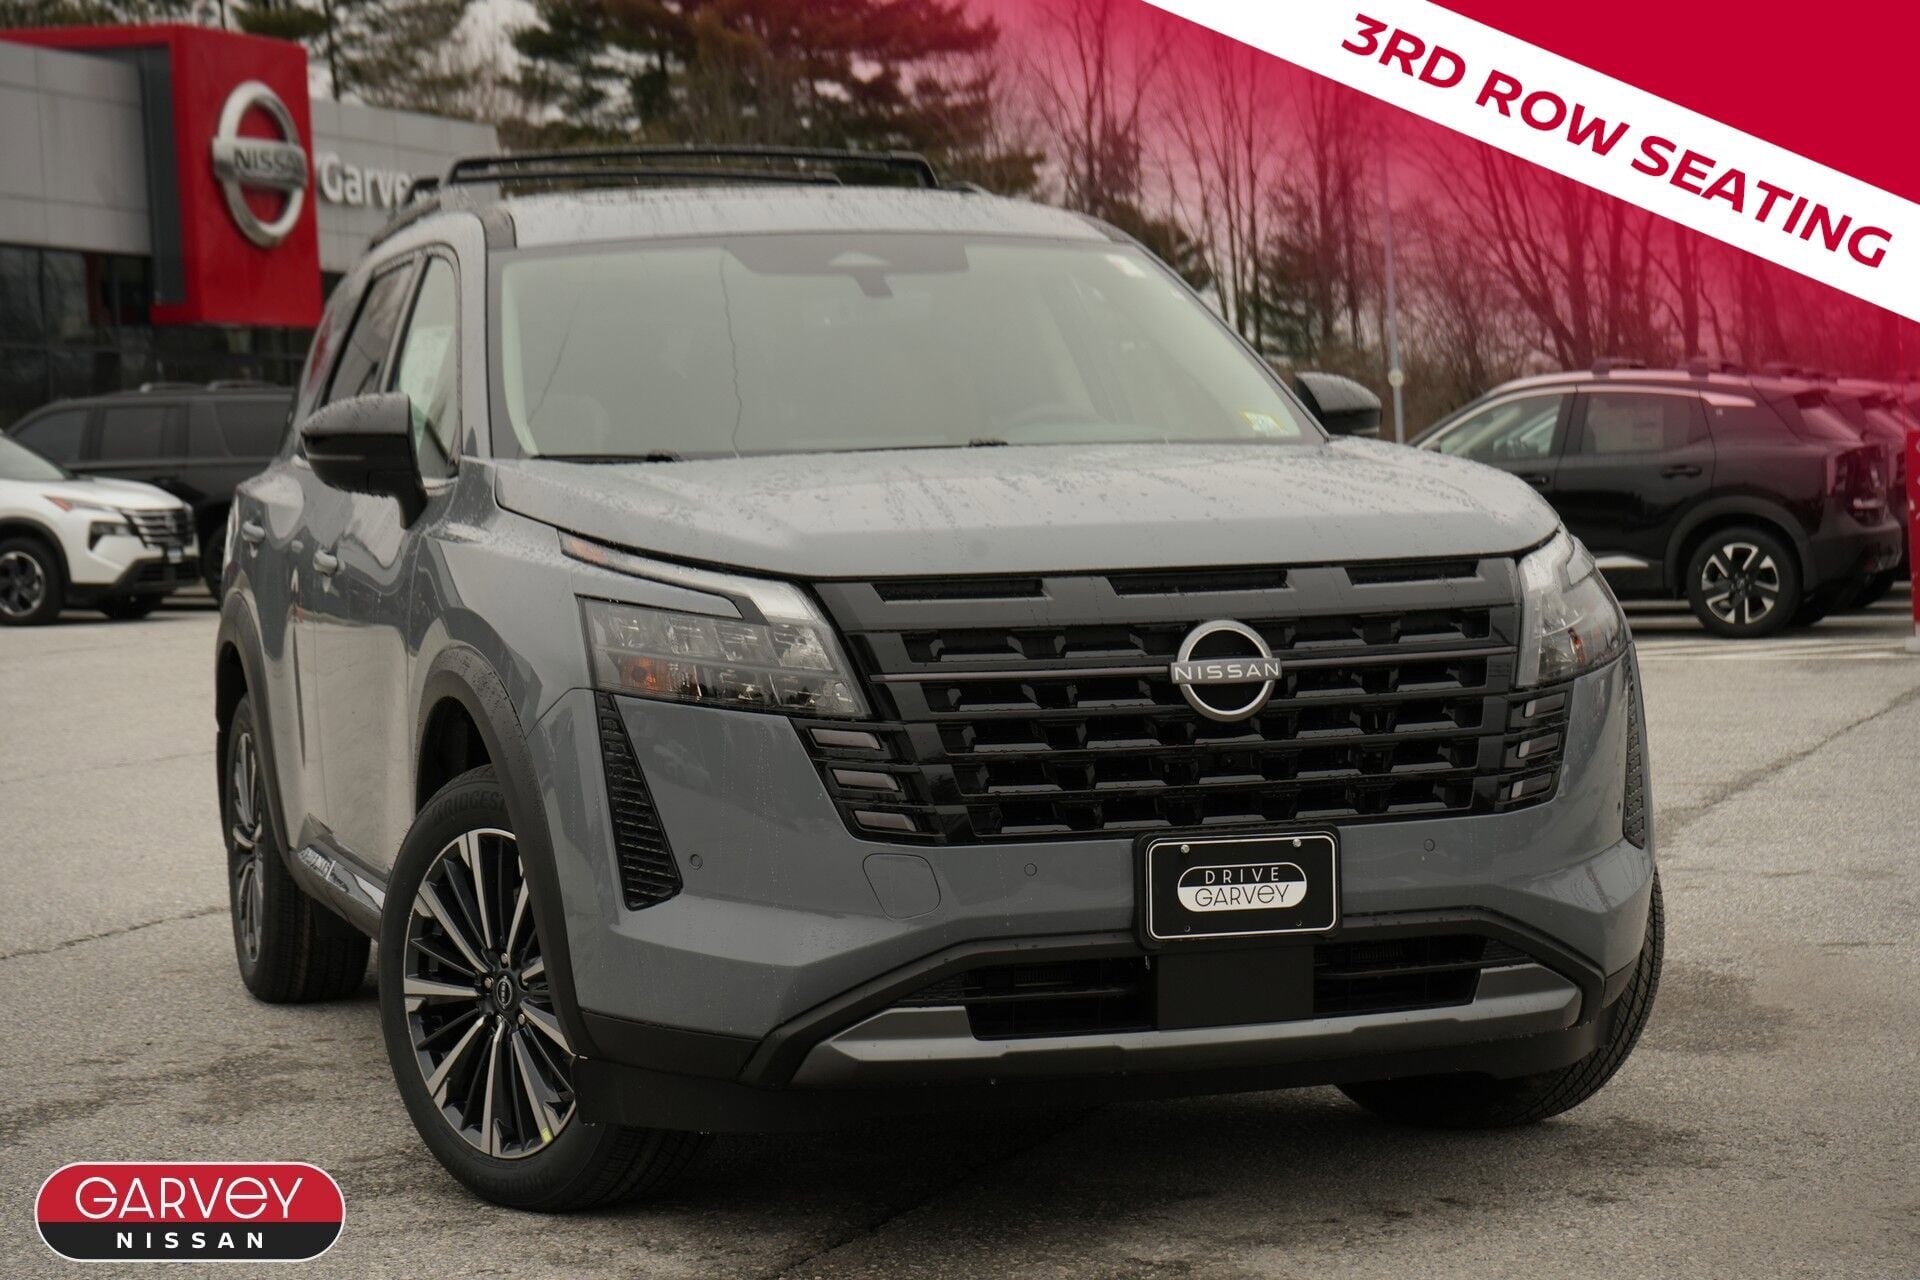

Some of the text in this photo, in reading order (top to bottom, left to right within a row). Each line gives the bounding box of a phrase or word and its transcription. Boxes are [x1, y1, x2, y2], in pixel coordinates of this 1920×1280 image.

[321, 154, 414, 207] Garve
[1174, 662, 1279, 681] NISSAN
[1205, 867, 1280, 885] DRIVE
